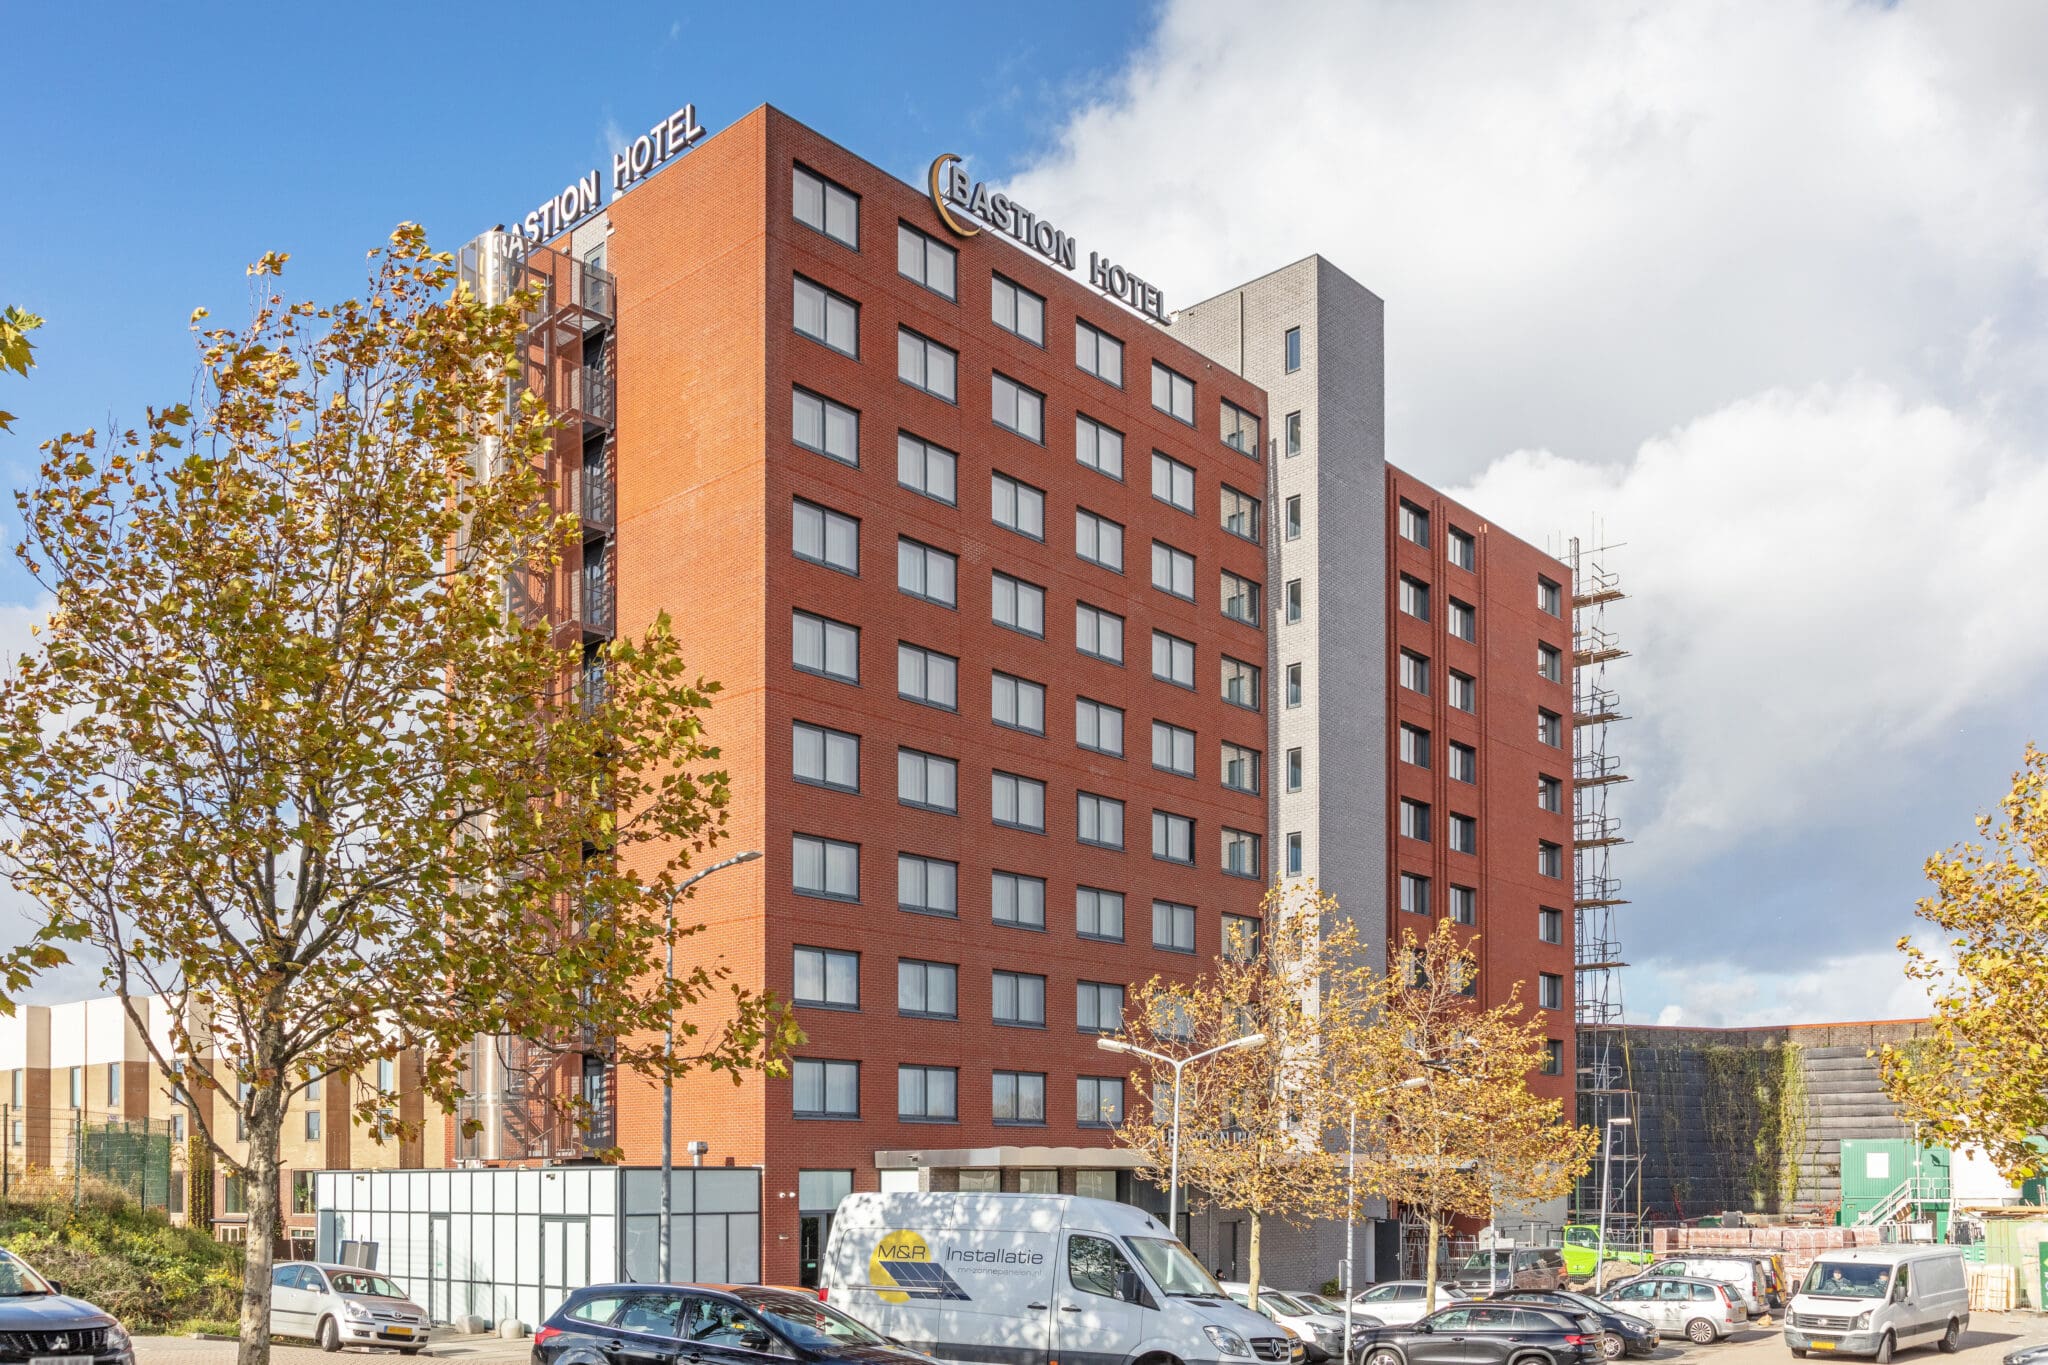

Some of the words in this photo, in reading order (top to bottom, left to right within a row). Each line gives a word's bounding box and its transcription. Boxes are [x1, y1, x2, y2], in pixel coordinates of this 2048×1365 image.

[613, 103, 707, 190] HOTEL
[951, 165, 1076, 271] BASTION
[1089, 251, 1172, 326] HOTEL
[878, 1244, 926, 1259] M&R
[946, 1246, 1043, 1265] Installatie
